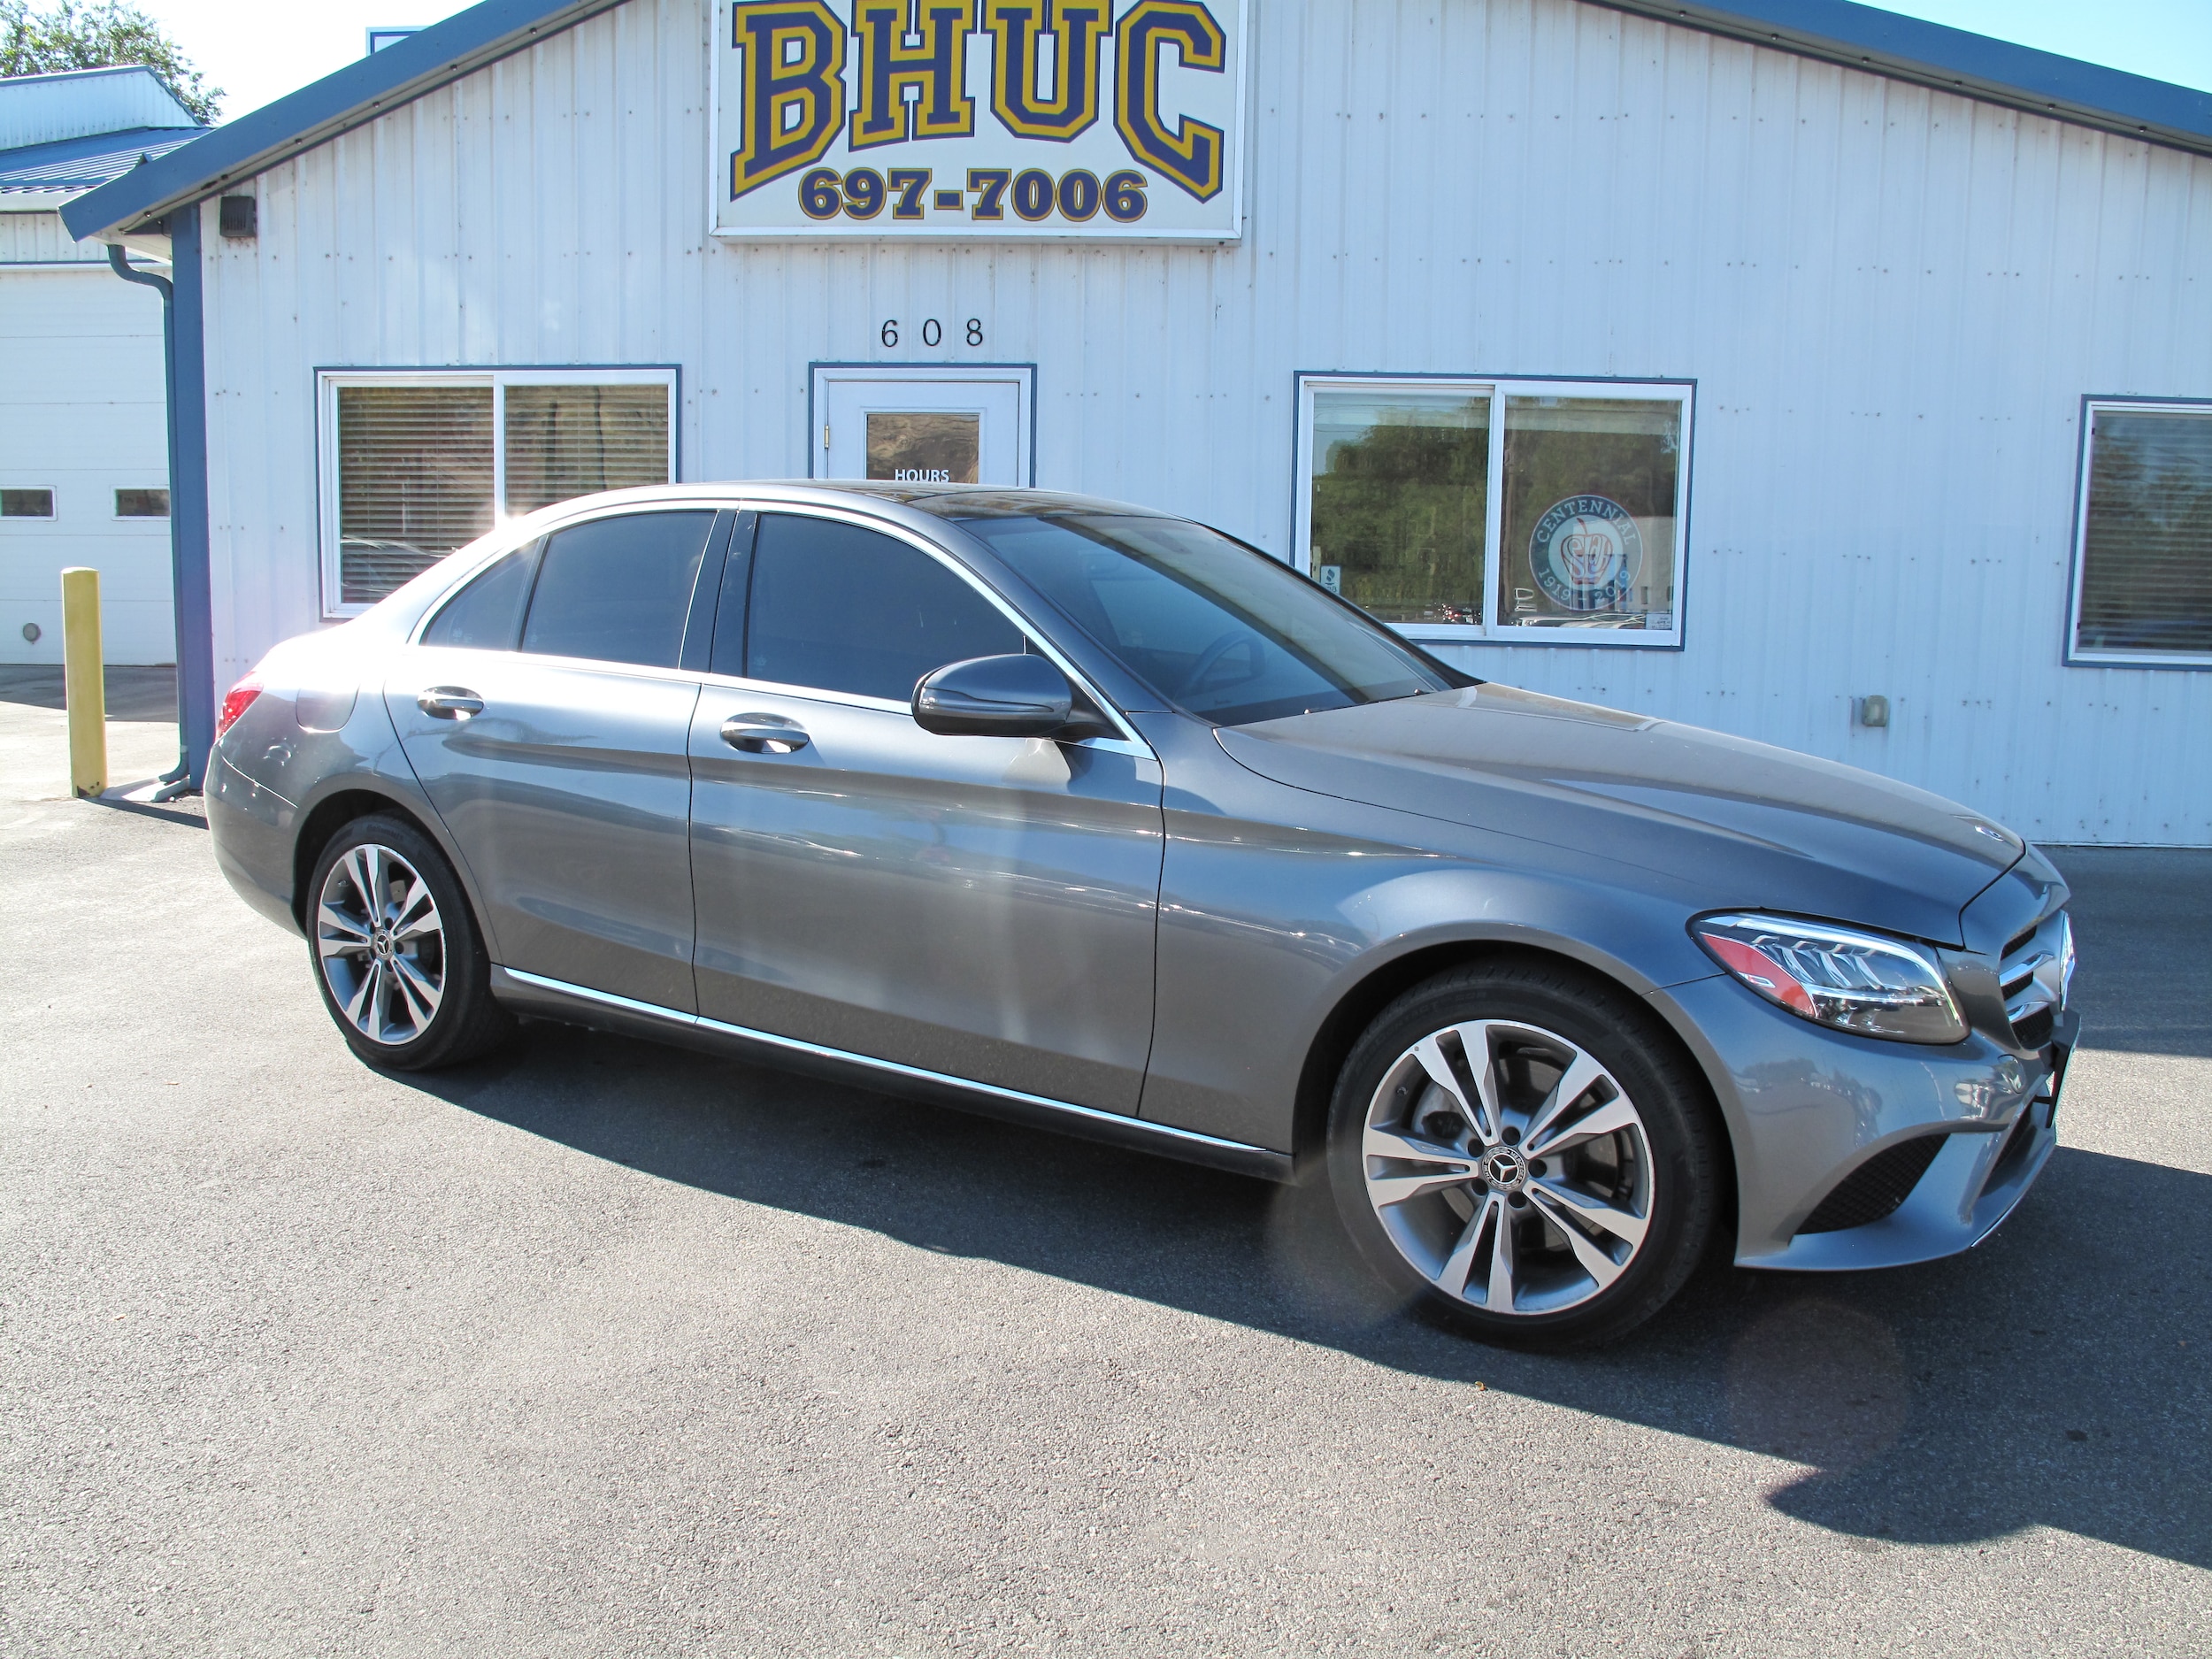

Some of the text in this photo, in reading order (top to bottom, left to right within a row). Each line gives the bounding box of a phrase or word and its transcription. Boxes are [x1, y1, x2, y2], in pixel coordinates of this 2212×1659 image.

[730, 0, 1227, 204] BHUC
[797, 167, 1148, 223] 697-7006
[881, 319, 983, 347] 608
[895, 468, 951, 483] HOURS
[1537, 499, 1636, 545] CENTENNIAL
[1538, 568, 1571, 602] 1919
[1594, 571, 1631, 603] 2019
